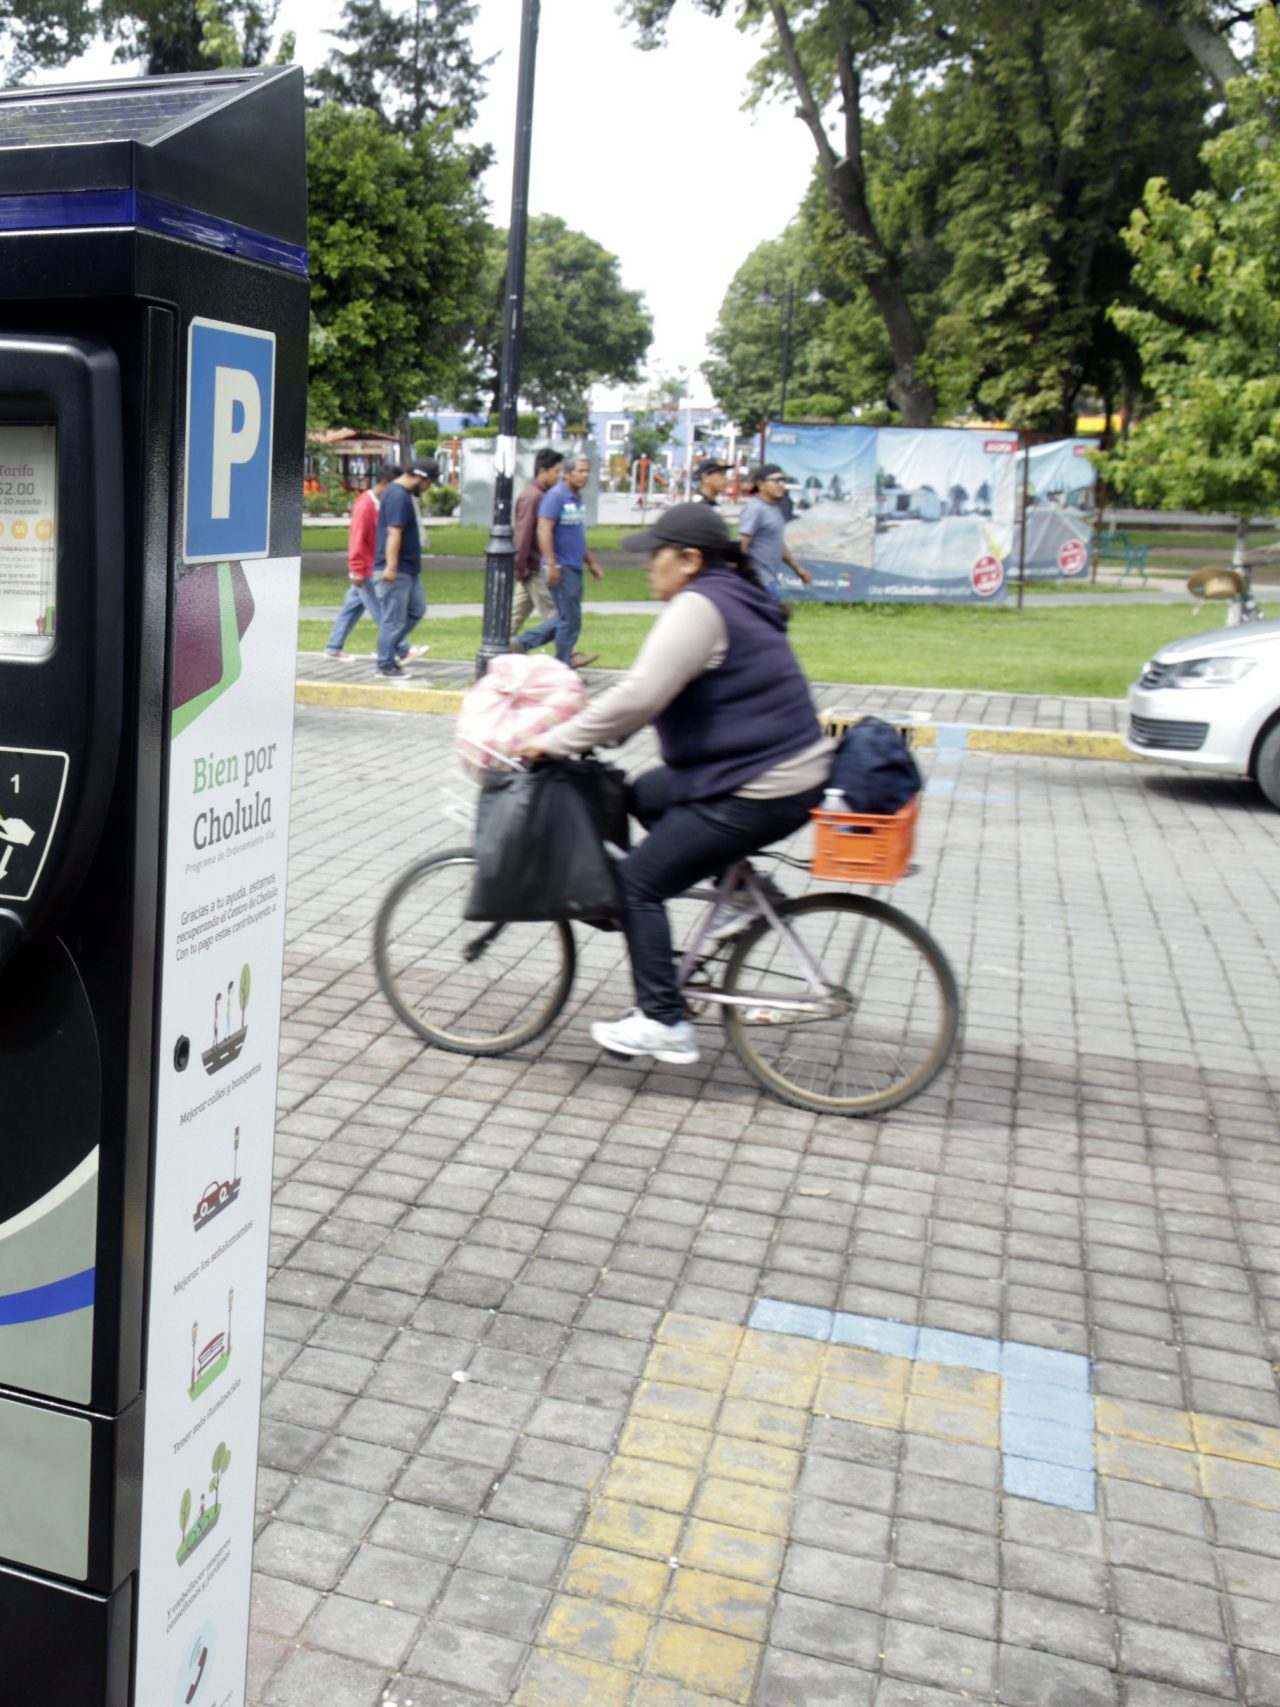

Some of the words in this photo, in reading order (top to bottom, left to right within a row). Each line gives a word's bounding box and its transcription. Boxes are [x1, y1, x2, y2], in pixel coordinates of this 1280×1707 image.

[210, 365, 262, 519] P
[3, 497, 14, 505] 20
[9, 774, 21, 794] 1
[192, 751, 239, 795] Bien
[243, 743, 277, 788] por
[193, 791, 272, 851] Cholula
[181, 905, 209, 926] Gracias
[210, 902, 215, 912] a
[216, 898, 224, 909] tu
[249, 873, 276, 894] estamos
[176, 914, 220, 945] recuperando
[176, 947, 189, 961] Con
[190, 941, 197, 954] tu
[198, 935, 214, 954] pago
